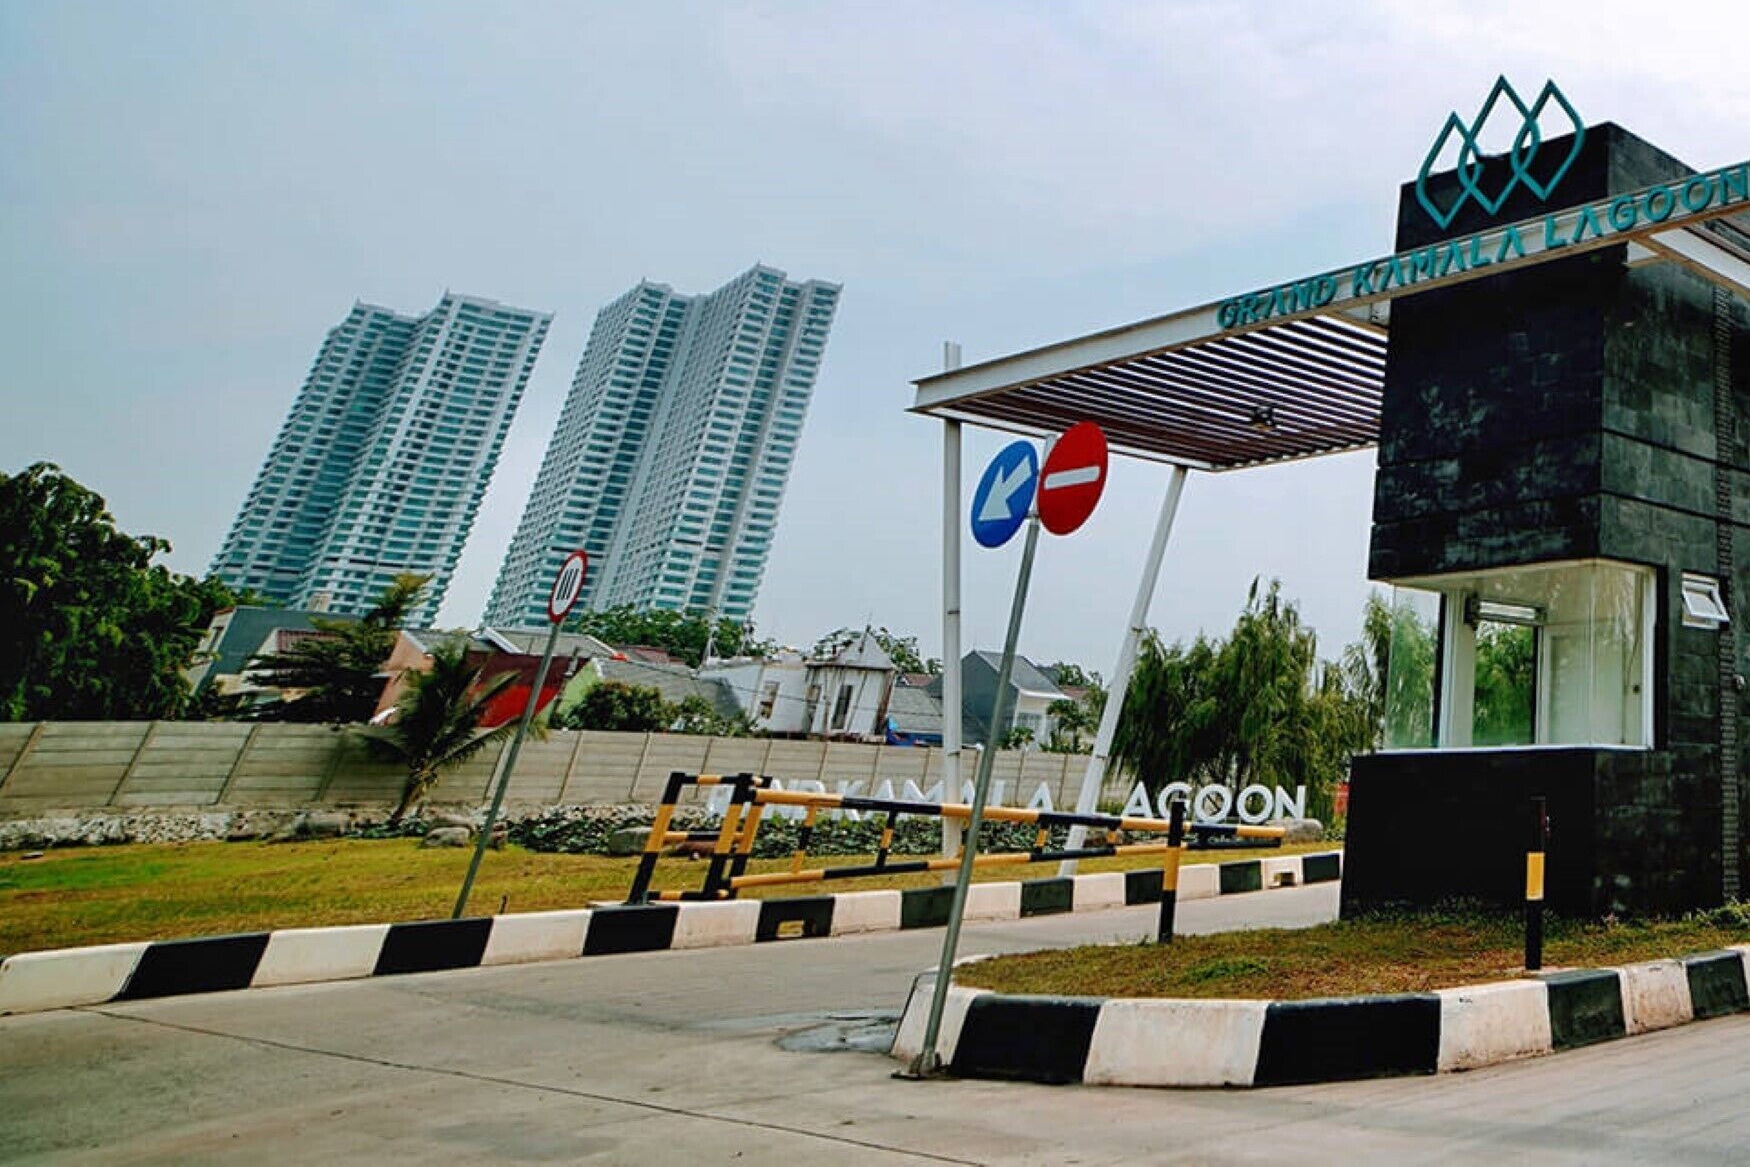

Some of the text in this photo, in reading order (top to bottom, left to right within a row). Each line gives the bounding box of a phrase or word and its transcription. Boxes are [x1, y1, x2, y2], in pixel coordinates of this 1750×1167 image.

[1217, 164, 1749, 329] GRAND KAMALA LAGOON
[1090, 781, 1306, 824] AGOON
